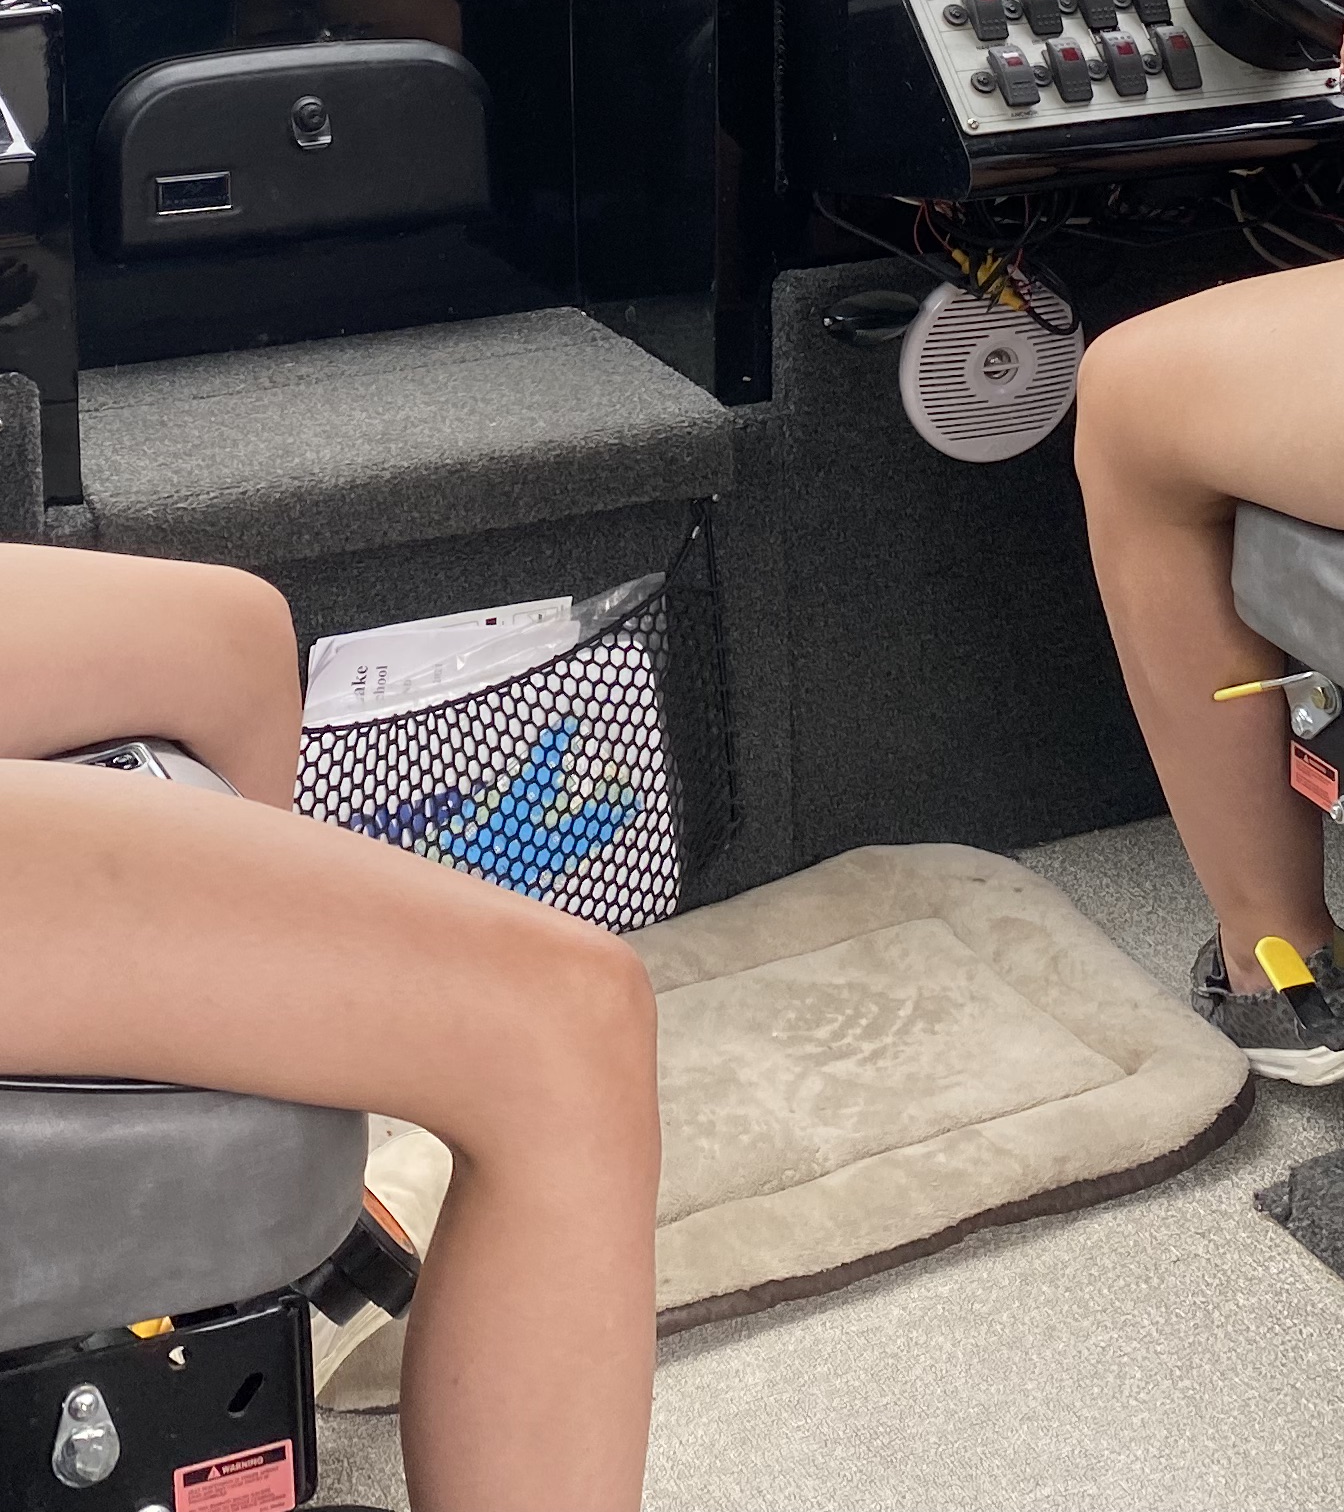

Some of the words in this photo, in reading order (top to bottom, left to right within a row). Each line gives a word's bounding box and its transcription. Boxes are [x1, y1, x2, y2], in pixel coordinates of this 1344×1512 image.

[351, 665, 369, 705] ake
[373, 665, 388, 702] chool
[222, 1455, 264, 1475] WARNING
